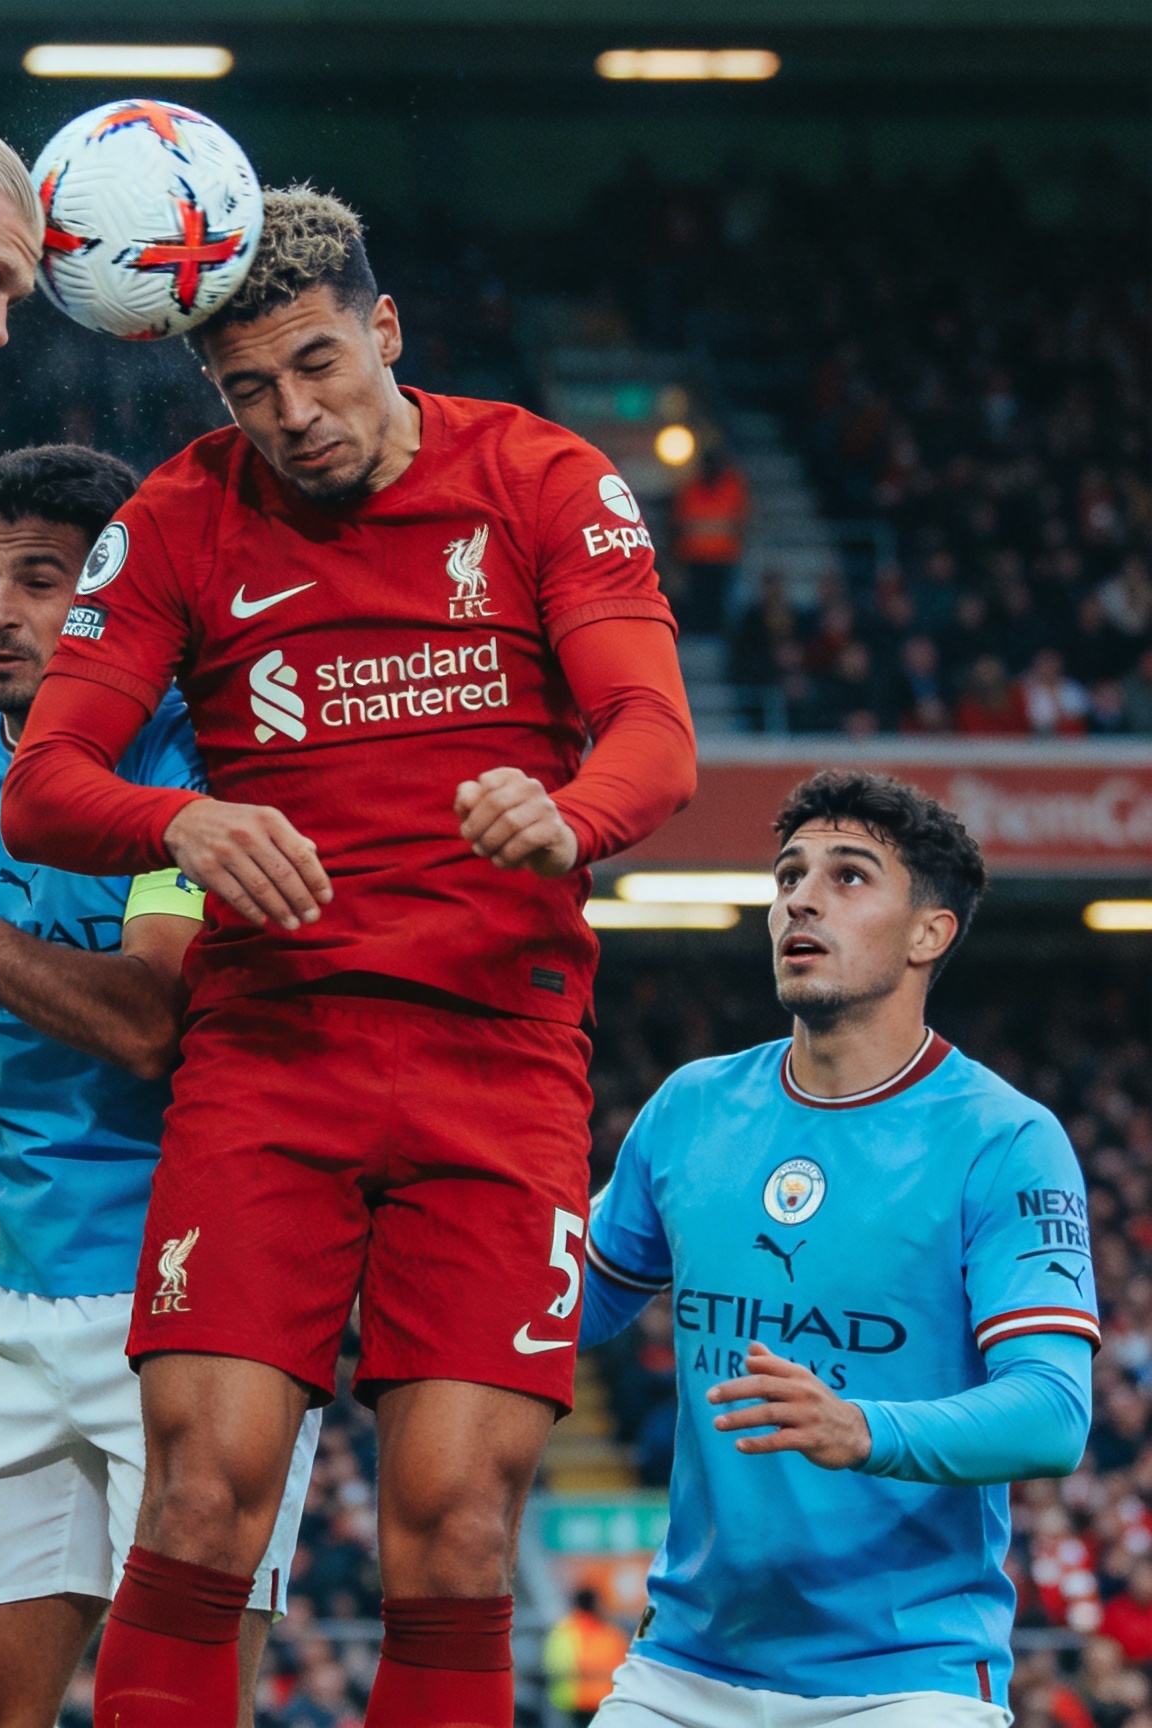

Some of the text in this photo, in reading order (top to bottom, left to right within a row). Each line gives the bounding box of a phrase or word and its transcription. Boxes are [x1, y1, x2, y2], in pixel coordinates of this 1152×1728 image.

[316, 636, 499, 691] standard
[321, 673, 509, 727] chartered
[548, 1206, 585, 1319] 5
[676, 1288, 908, 1355] ETIHAD
